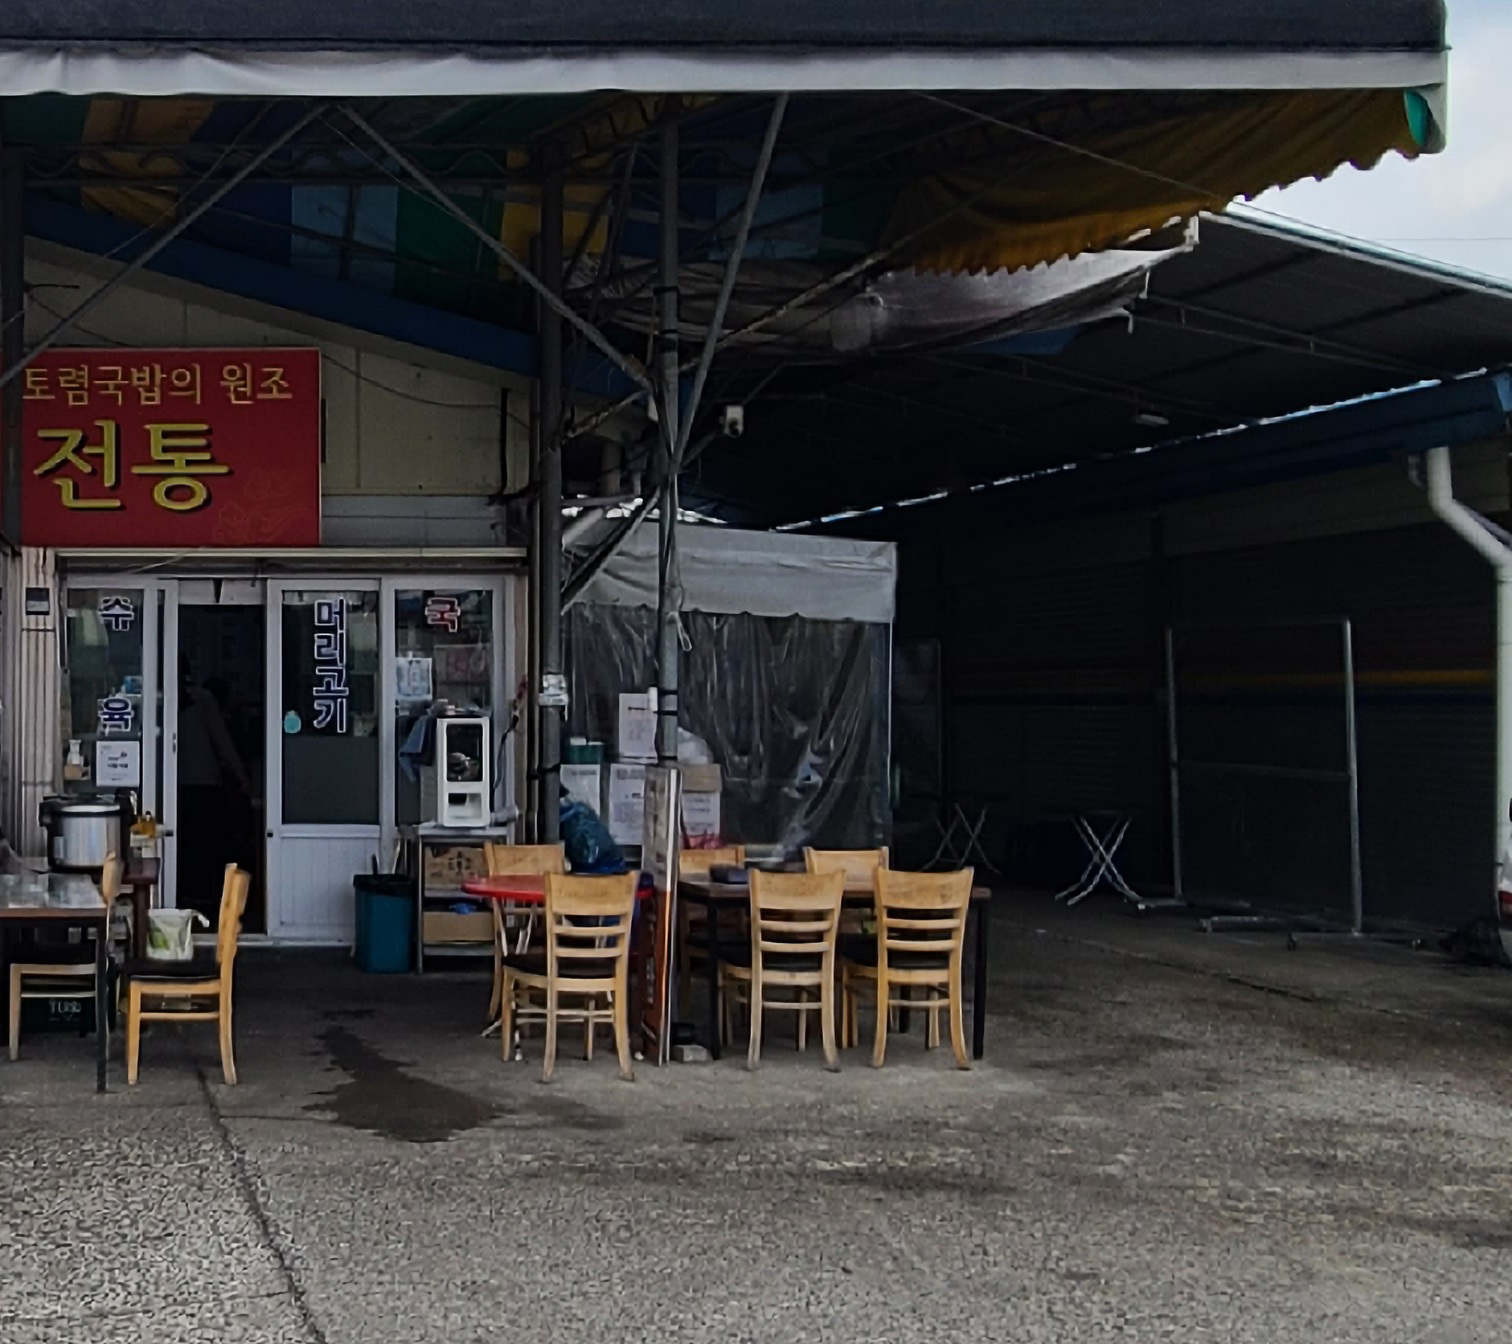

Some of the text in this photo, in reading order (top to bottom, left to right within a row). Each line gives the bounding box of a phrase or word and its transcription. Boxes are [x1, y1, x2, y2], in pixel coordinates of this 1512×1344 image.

[21, 364, 202, 405] 토렴국밥의
[219, 364, 294, 404] 원조
[33, 419, 230, 511] 전통
[313, 597, 349, 733] 머리고기
